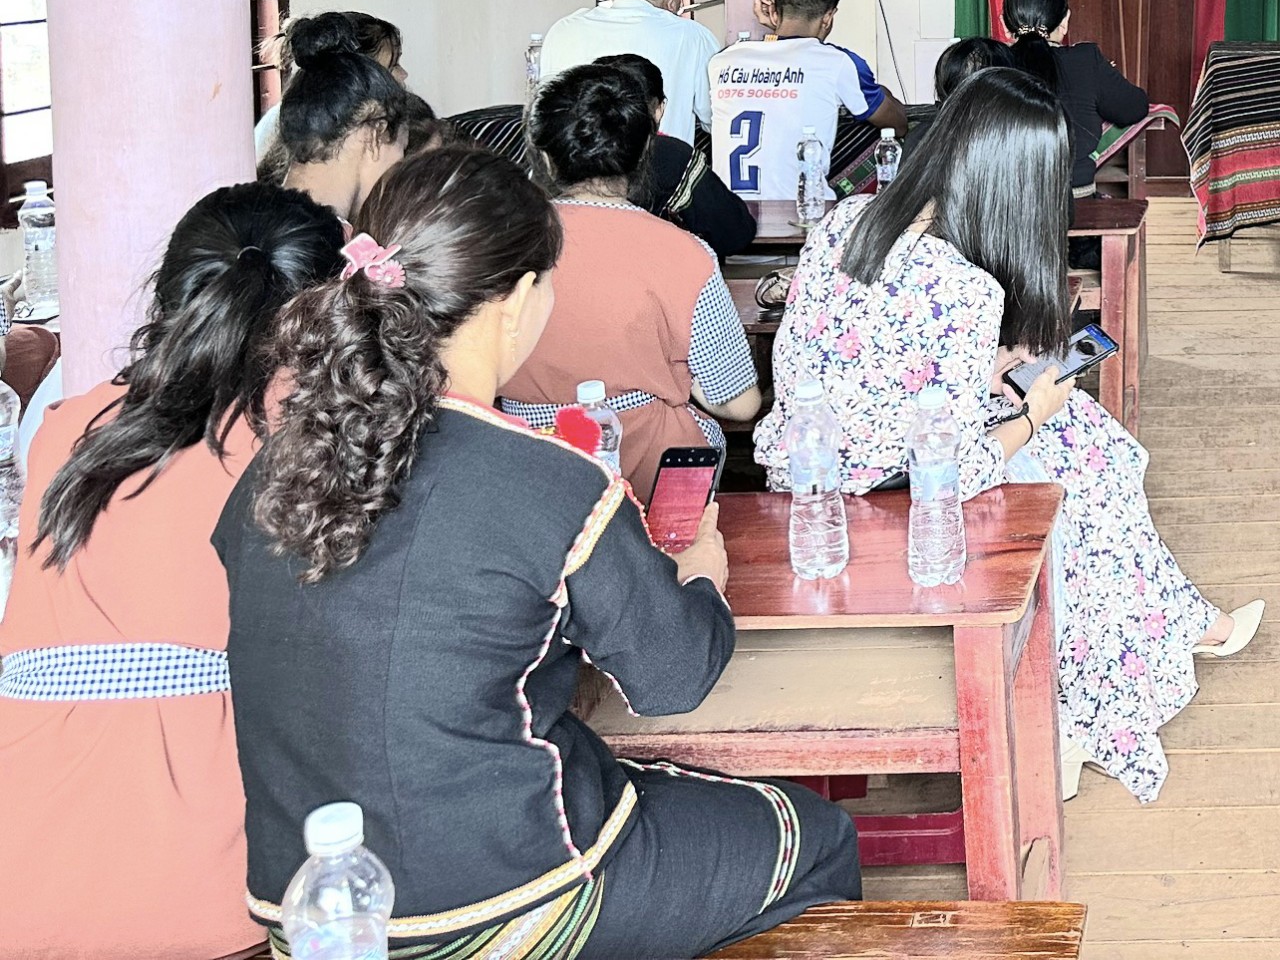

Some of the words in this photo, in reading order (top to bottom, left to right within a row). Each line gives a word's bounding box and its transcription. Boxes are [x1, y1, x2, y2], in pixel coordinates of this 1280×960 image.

[750, 67, 782, 88] Hoàng
[782, 66, 805, 84] Anh
[717, 88, 745, 100] 0976
[746, 88, 799, 100] 906606
[730, 111, 765, 194] 2
